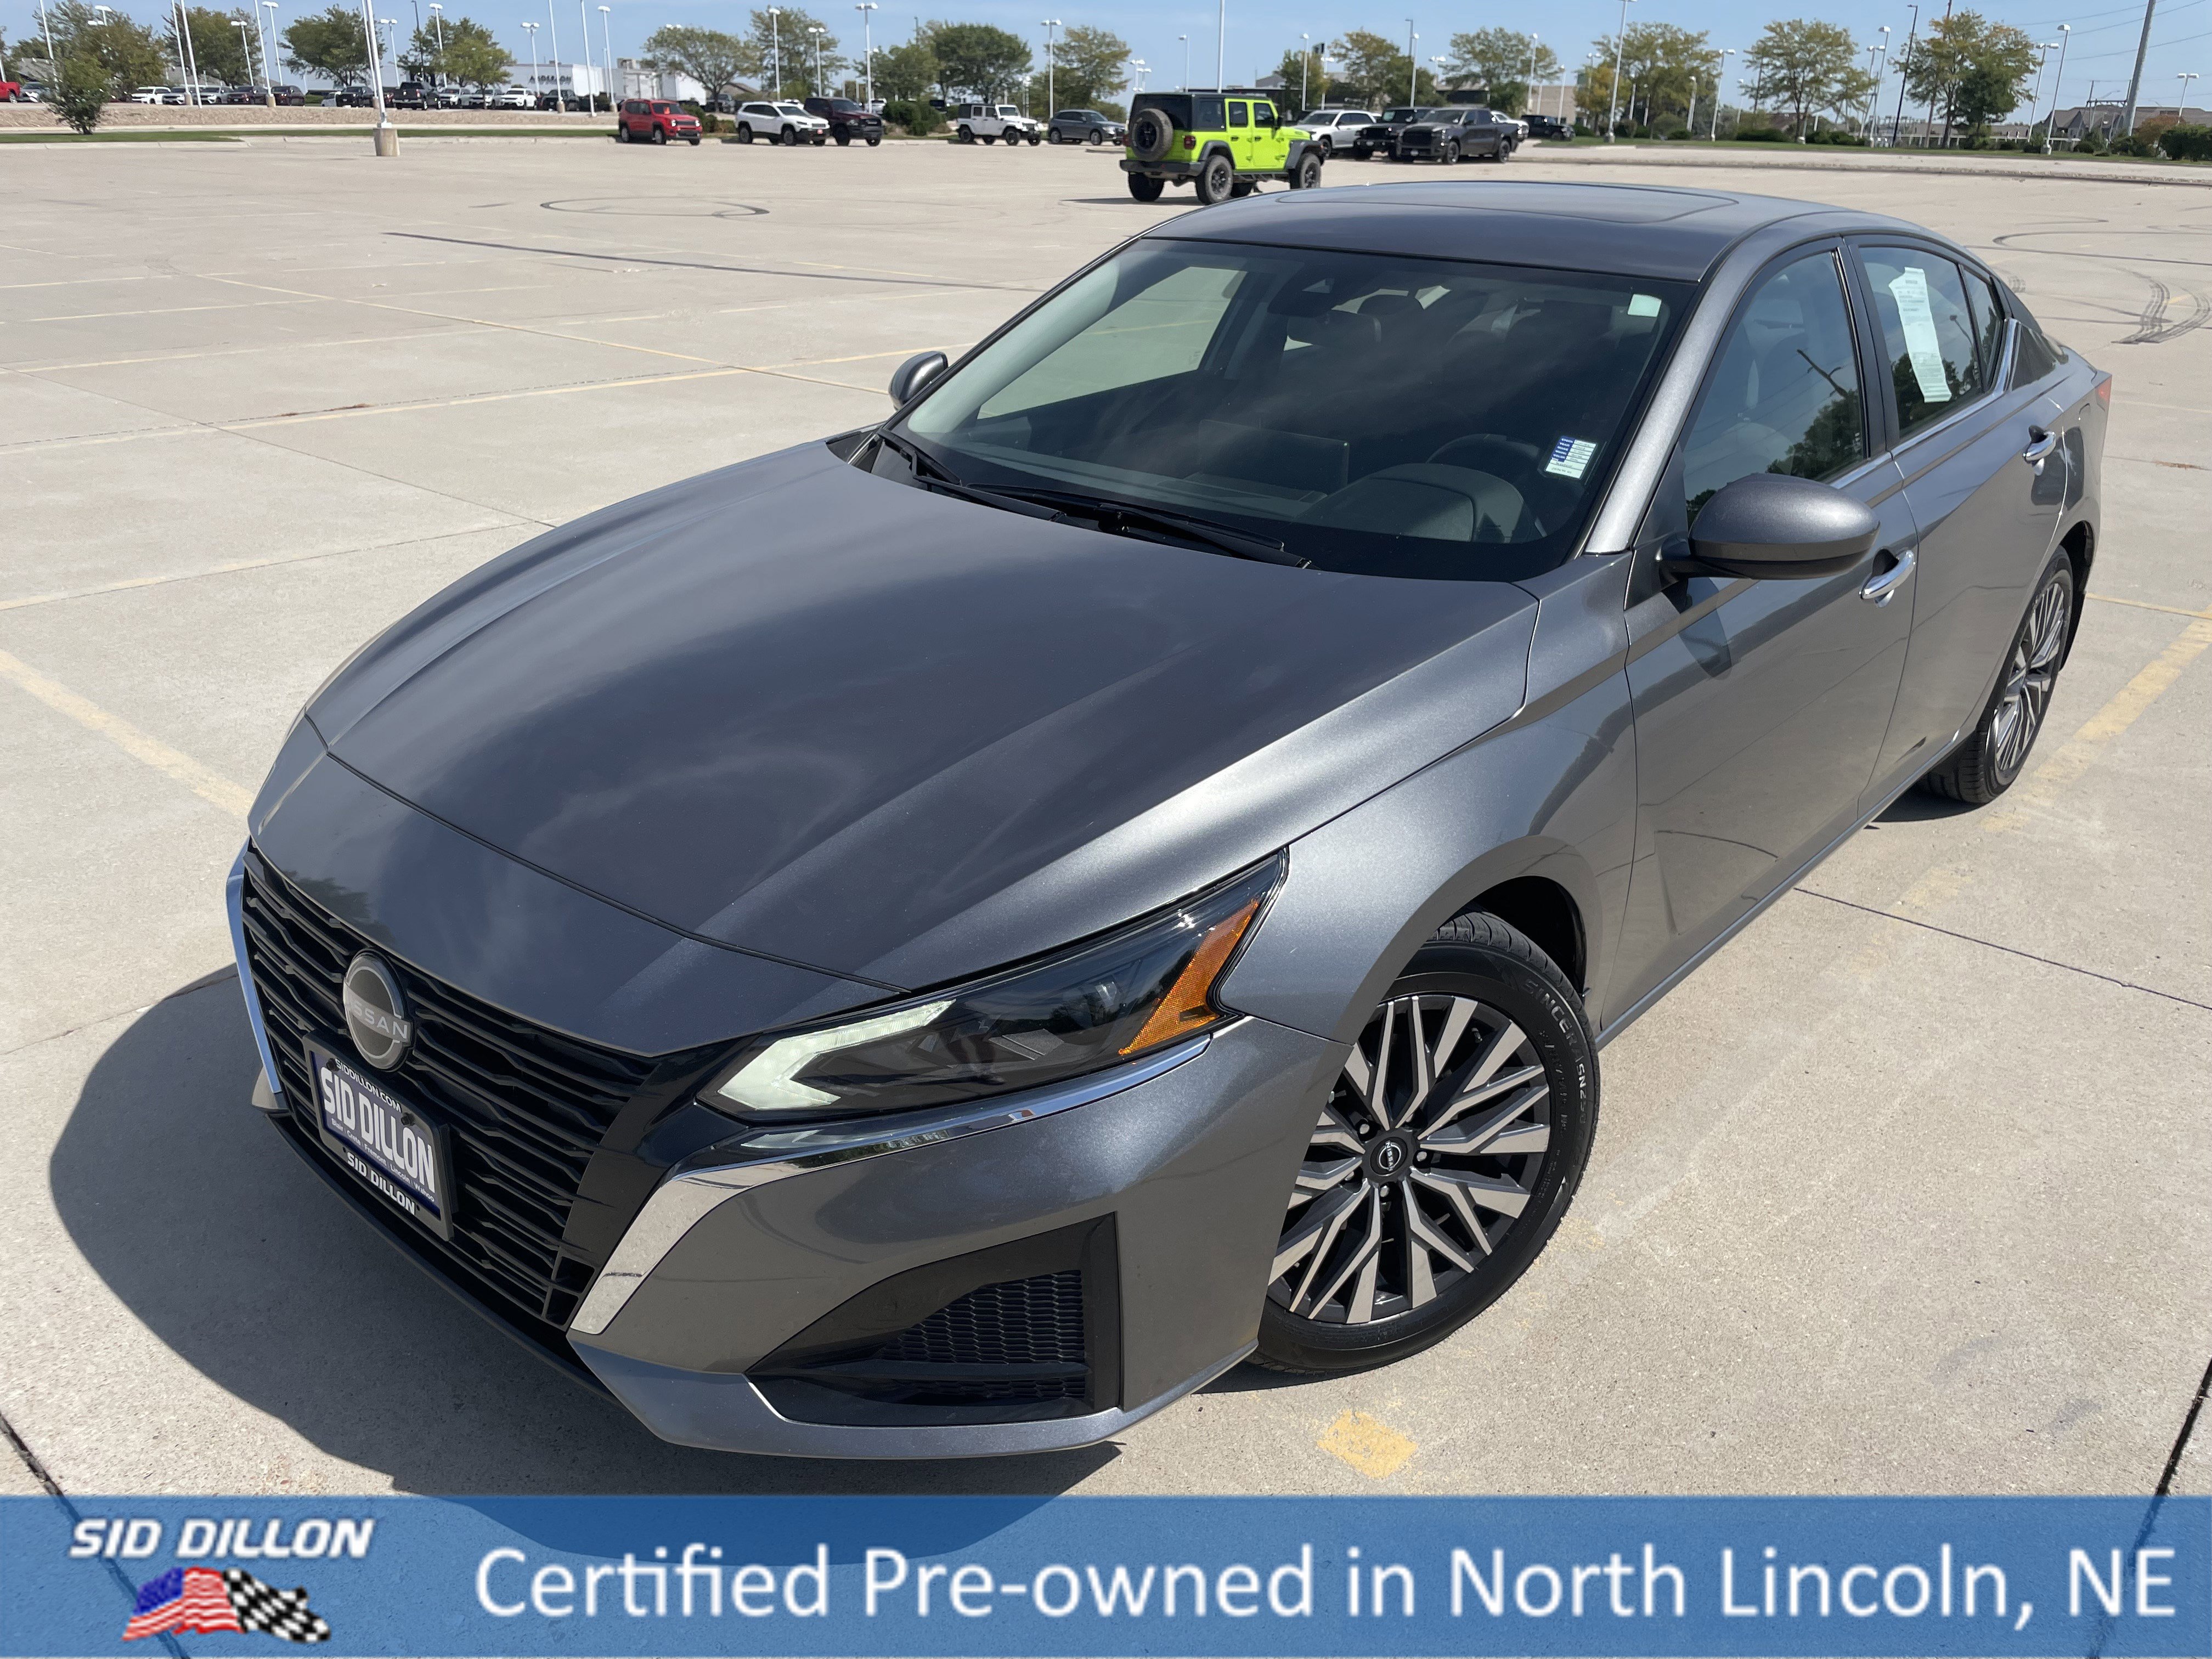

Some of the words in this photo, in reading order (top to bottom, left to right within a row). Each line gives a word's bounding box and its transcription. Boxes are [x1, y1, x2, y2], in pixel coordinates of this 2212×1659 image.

[527, 75, 571, 85] ANDERON
[335, 1058, 402, 1113] SIDDILLON.COM
[321, 1066, 356, 1131] SID
[359, 1092, 436, 1193] DILLON
[1385, 1142, 1393, 1171] NISSAN
[331, 1118, 343, 1132] Blair
[347, 1130, 361, 1146] Crete
[364, 1143, 387, 1166] Fremont
[390, 1164, 410, 1184] Lincoln
[414, 1181, 435, 1202] Wahoo
[347, 1152, 367, 1177] SID
[371, 1170, 415, 1215] DILLON
